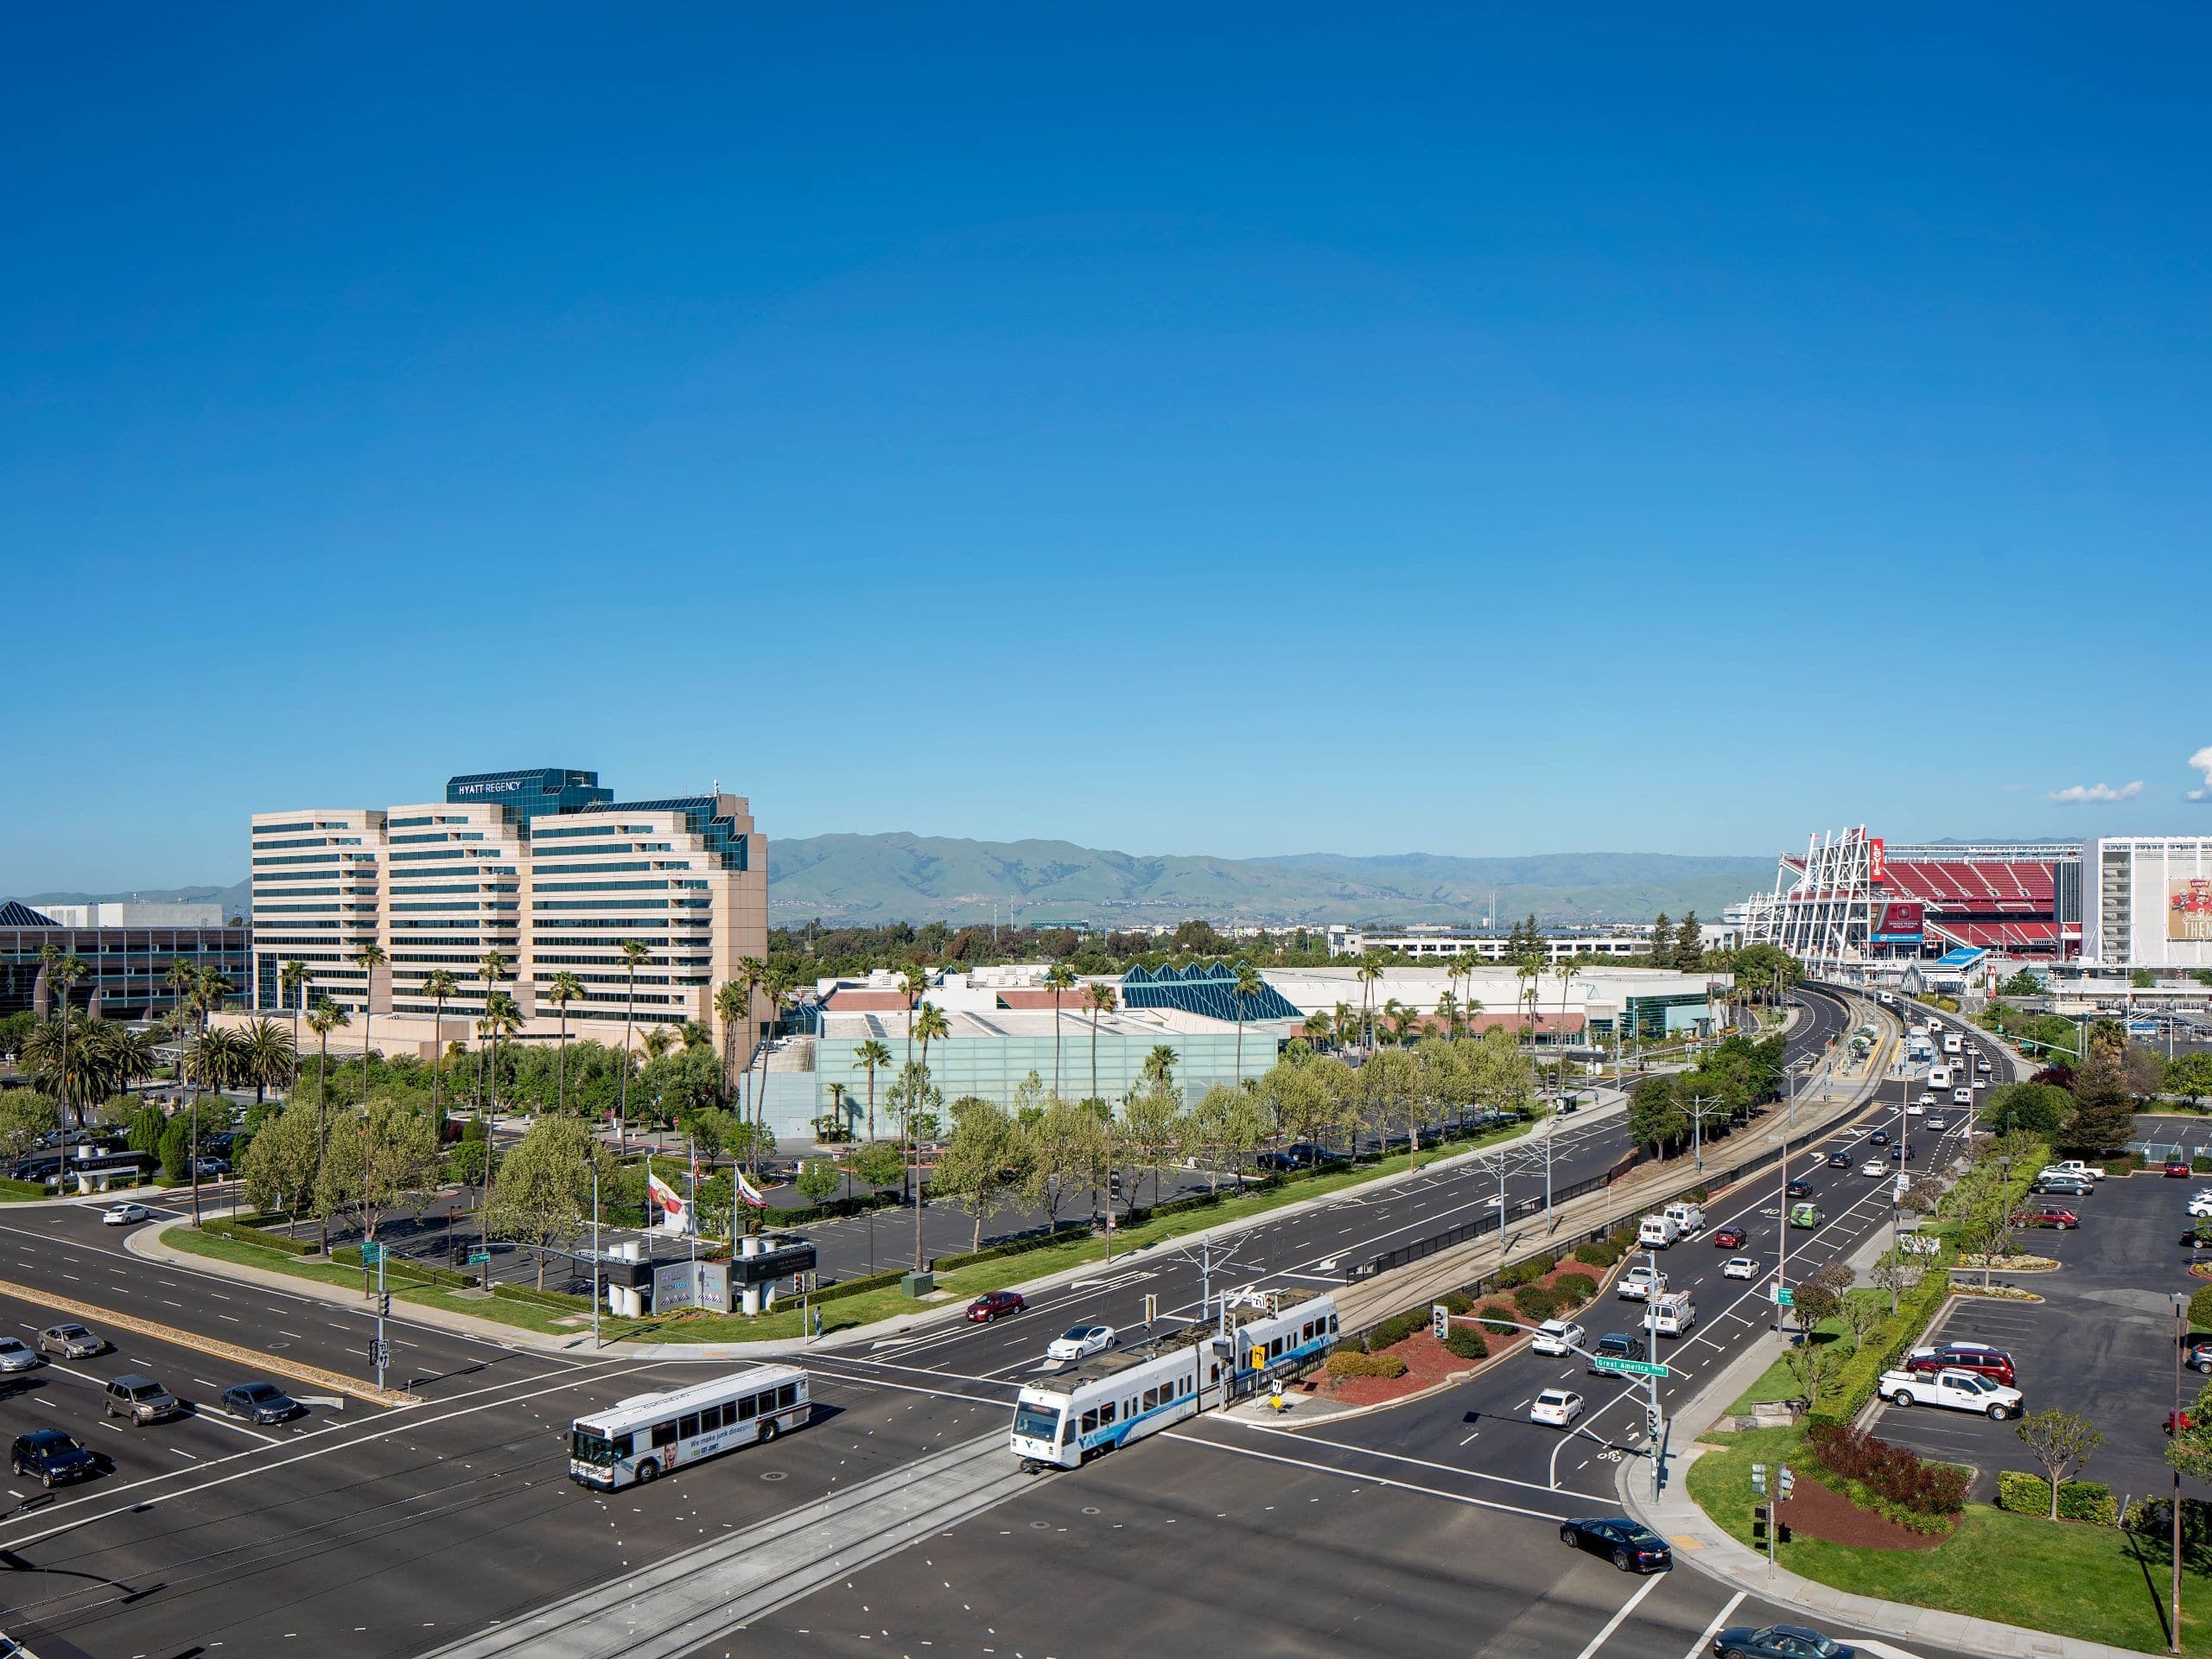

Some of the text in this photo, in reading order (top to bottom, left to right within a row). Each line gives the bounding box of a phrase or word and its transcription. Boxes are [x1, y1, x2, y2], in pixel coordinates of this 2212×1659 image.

[459, 781, 520, 795] HYATT REGENCY
[1599, 1359, 1618, 1368] Great
[1620, 1363, 1649, 1372] America
[700, 1434, 715, 1445] make
[716, 1431, 728, 1441] junk
